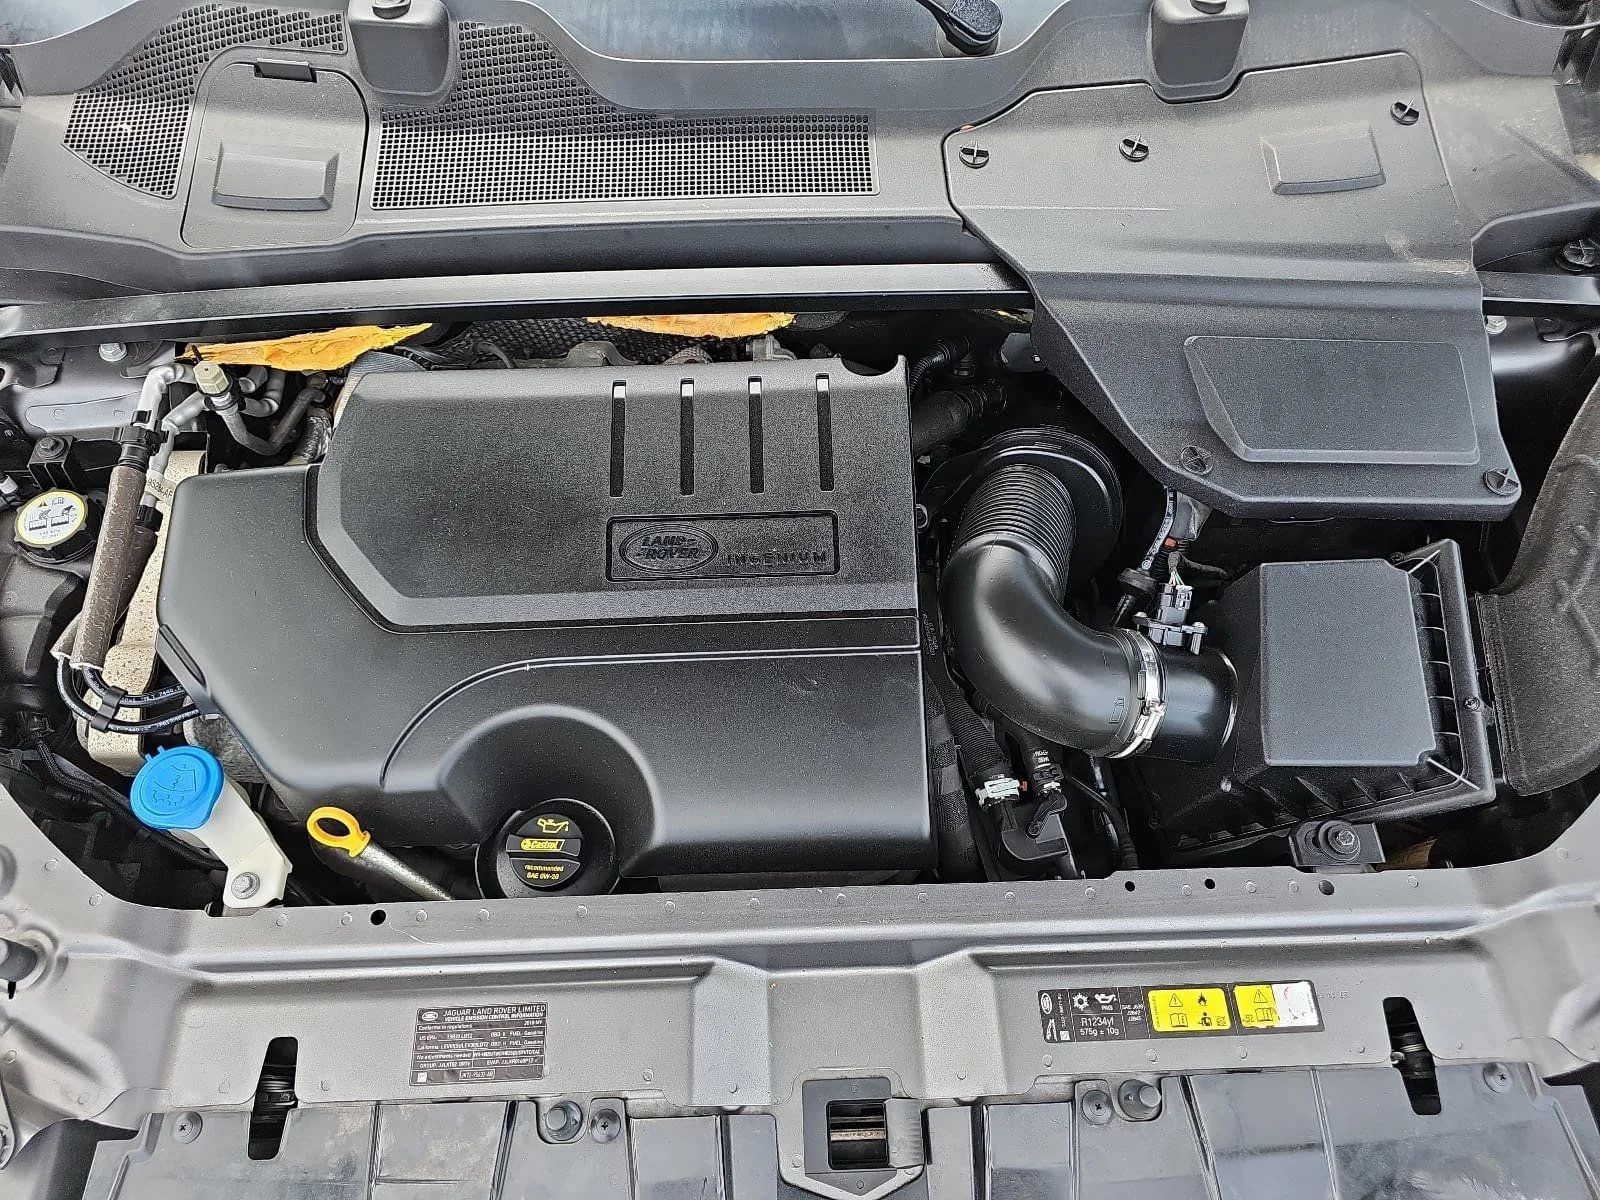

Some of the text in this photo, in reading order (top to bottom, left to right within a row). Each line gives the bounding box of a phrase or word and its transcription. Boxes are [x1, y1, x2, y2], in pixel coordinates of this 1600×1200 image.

[641, 535, 688, 547] LAND
[644, 547, 700, 561] ROVER
[727, 551, 827, 566] INGENIUM
[530, 839, 558, 849] Castrol
[524, 864, 564, 872] recommended
[443, 1008, 470, 1017] JAGUAR
[472, 1007, 492, 1015] LAND
[493, 1006, 517, 1015] ROVER
[518, 1004, 546, 1013] LIMITED
[1080, 1016, 1114, 1027] R1234yf
[1079, 1028, 1098, 1037] 575g
[1106, 1027, 1120, 1036] 10g
